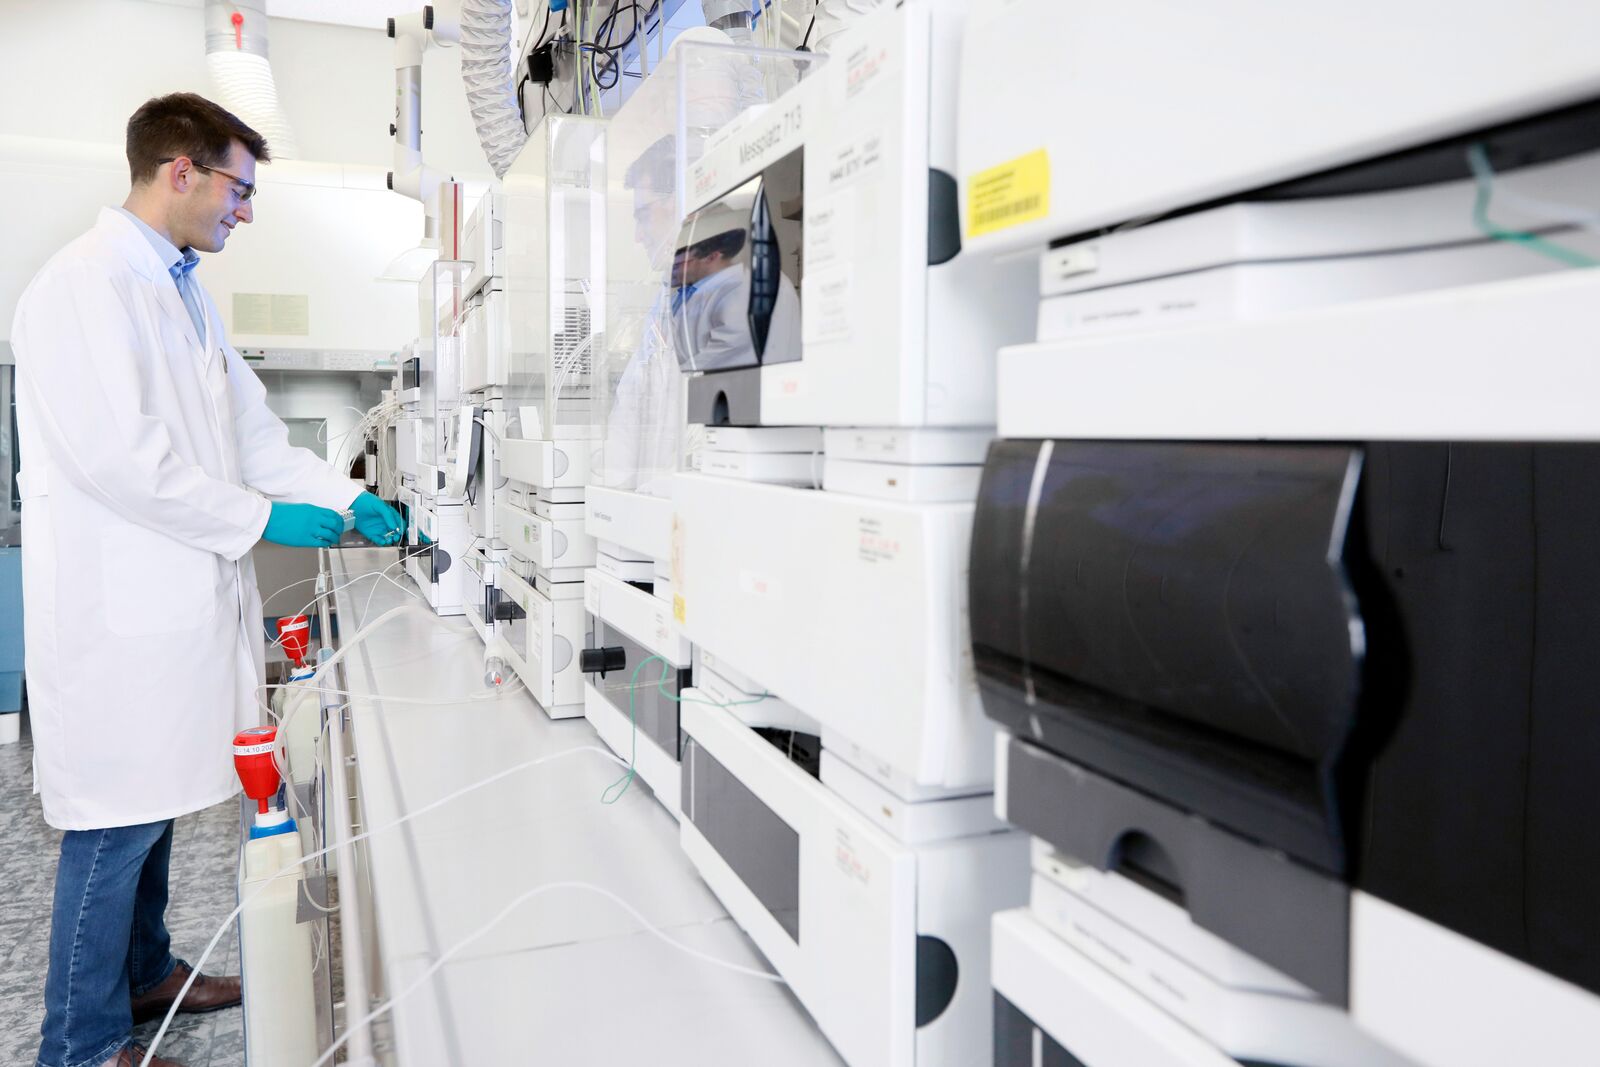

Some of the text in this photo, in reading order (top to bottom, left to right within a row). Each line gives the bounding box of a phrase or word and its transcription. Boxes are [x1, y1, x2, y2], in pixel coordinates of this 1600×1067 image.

[739, 122, 781, 166] Messplatz
[784, 104, 802, 137] 713
[243, 744, 273, 753] 14.10.202
